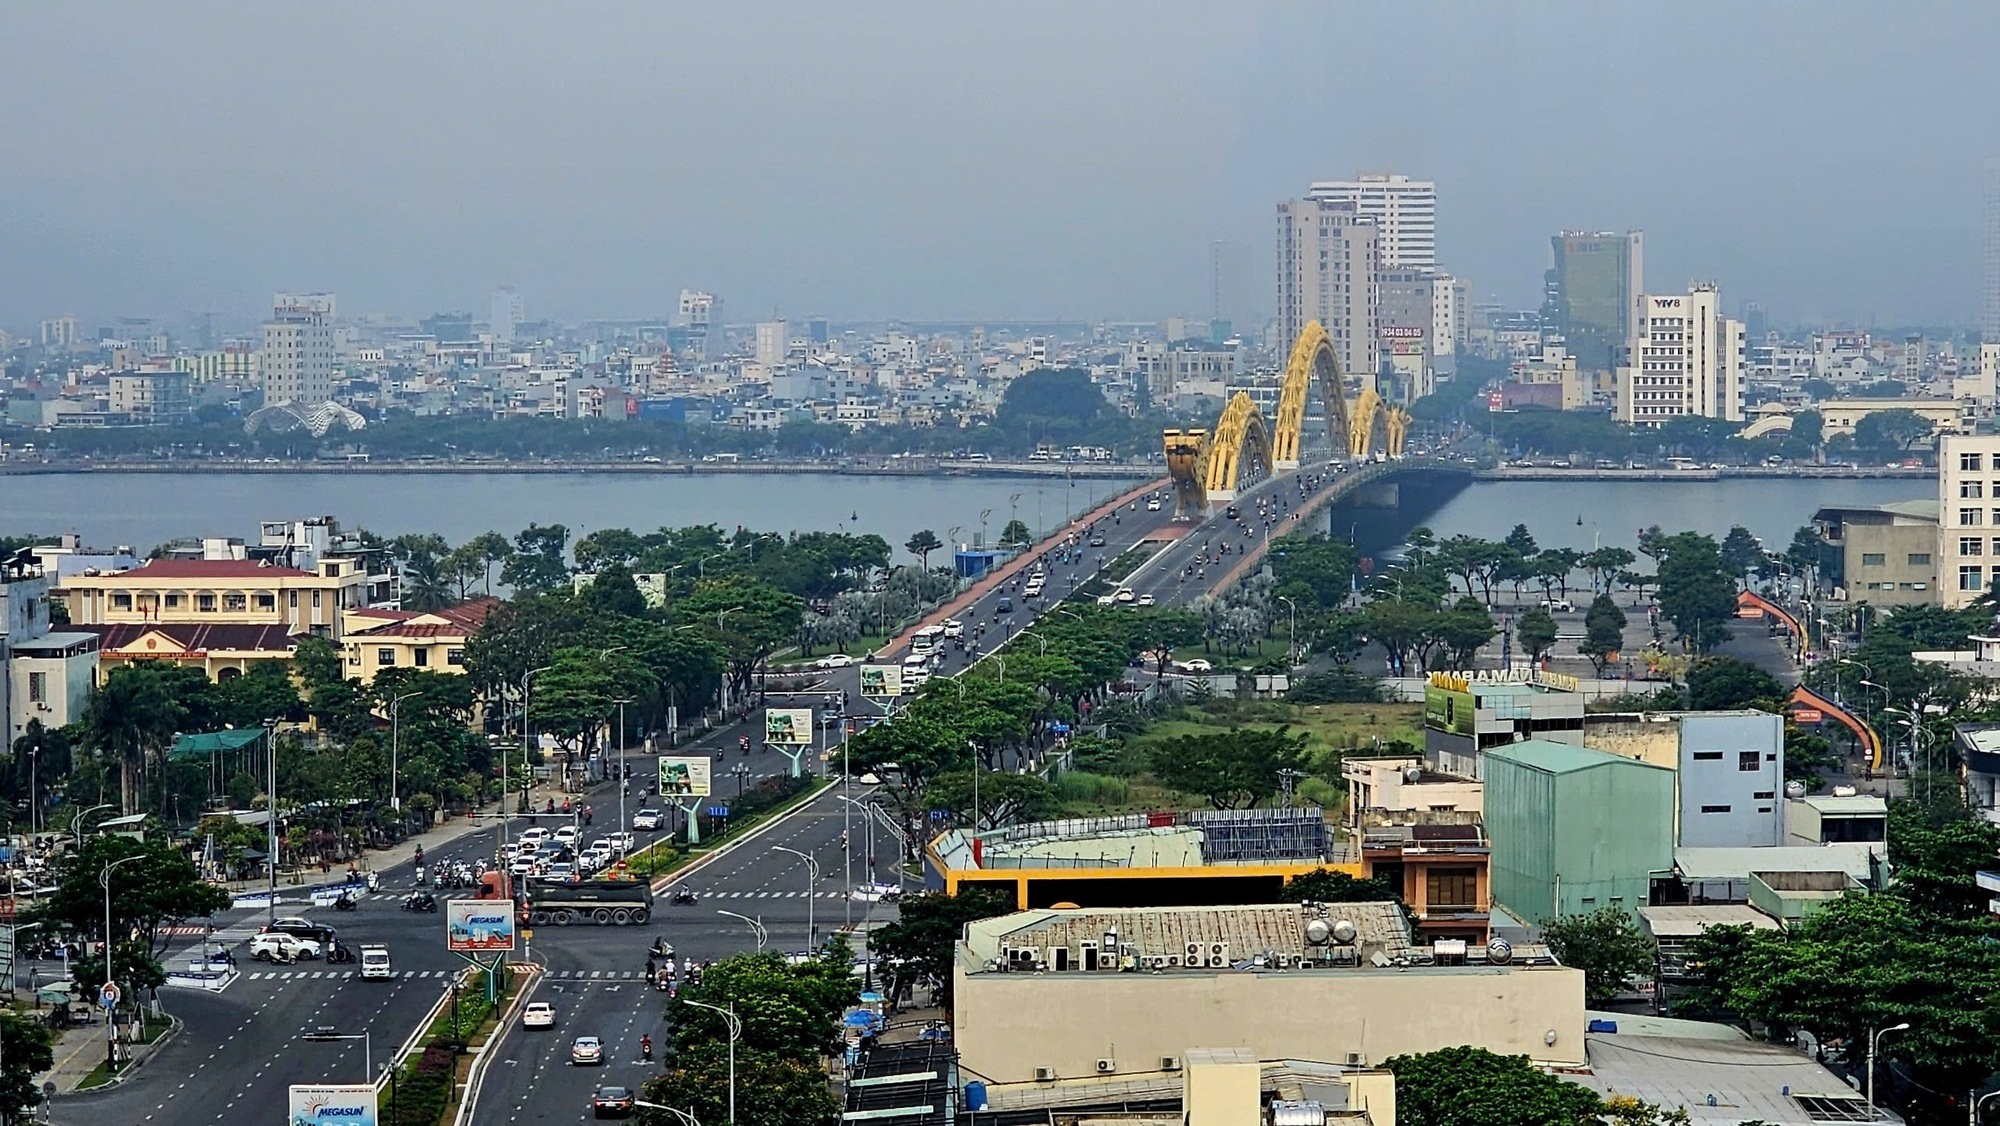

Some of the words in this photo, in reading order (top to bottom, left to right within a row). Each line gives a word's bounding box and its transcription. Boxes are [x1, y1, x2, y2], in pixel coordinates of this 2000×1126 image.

[1654, 299, 1680, 308] VTV8
[469, 916, 505, 925] MEGASUN
[318, 1106, 365, 1118] MEGASUN
